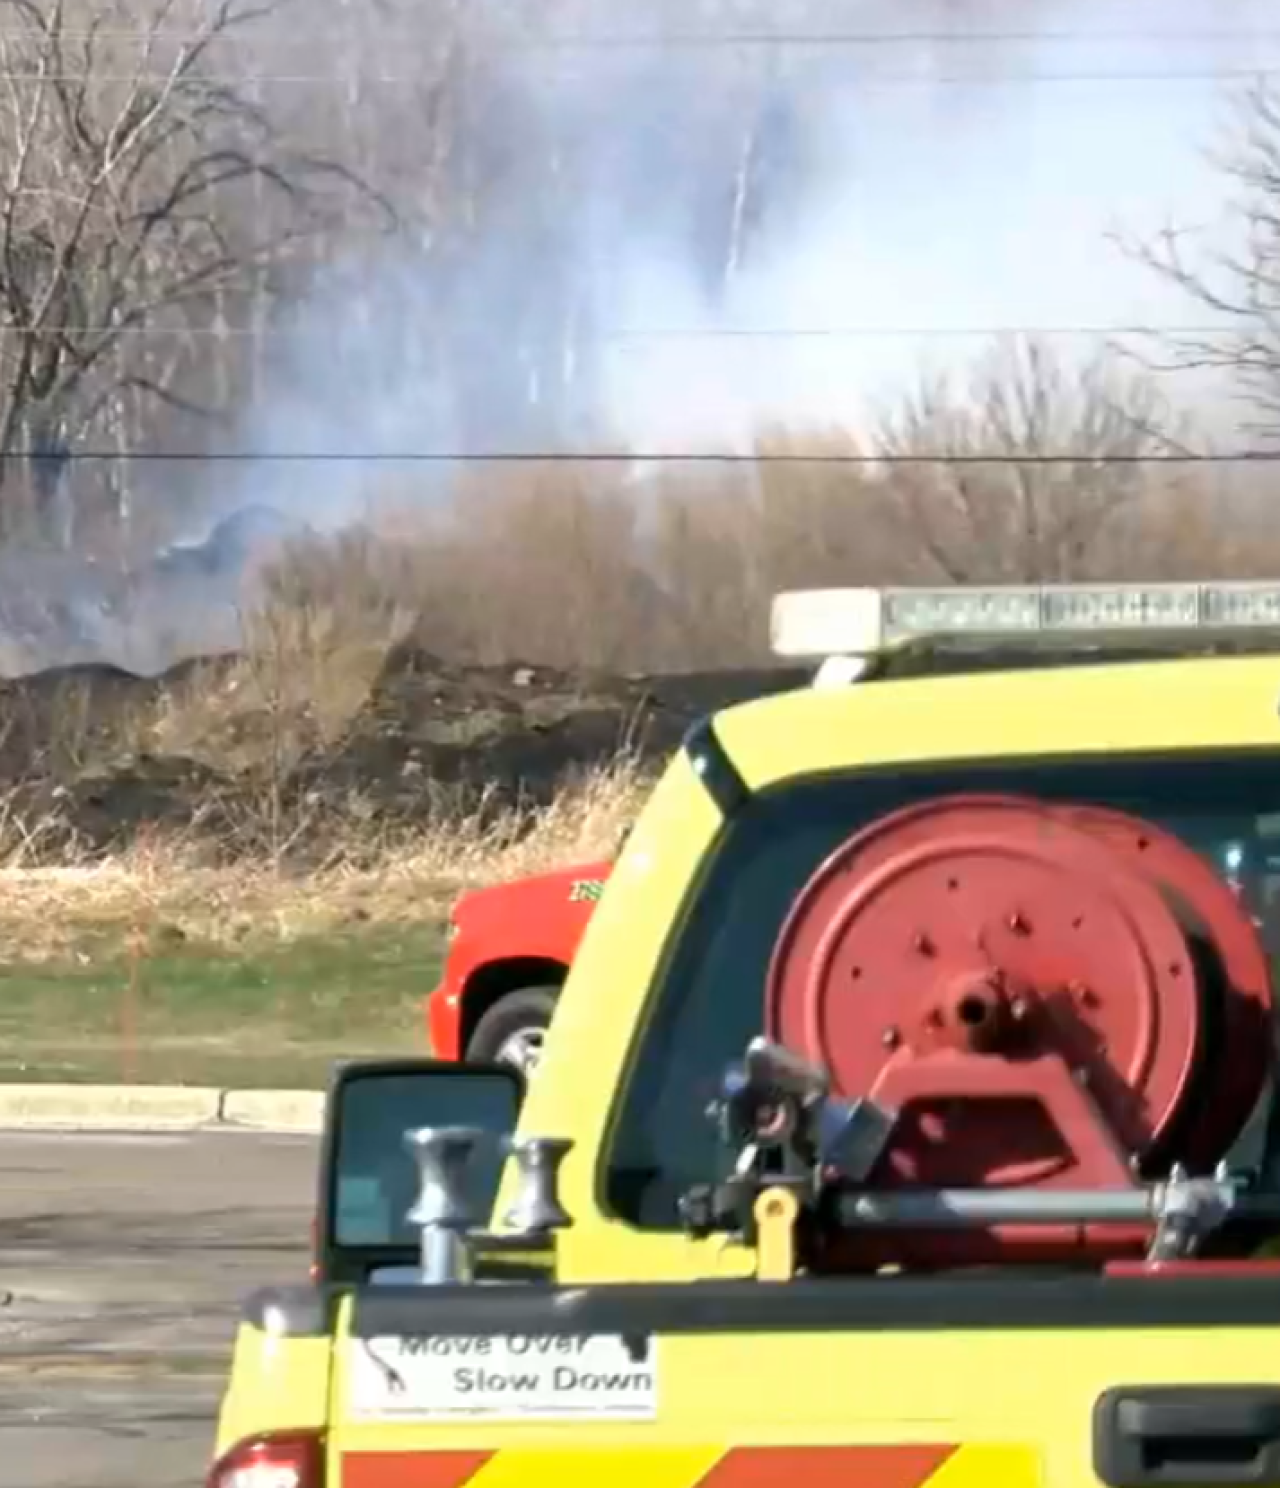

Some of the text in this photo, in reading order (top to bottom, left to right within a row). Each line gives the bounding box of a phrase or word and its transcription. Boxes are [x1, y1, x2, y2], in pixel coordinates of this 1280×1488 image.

[398, 1334, 590, 1356] Move Over
[453, 1365, 652, 1393] Slow Down
